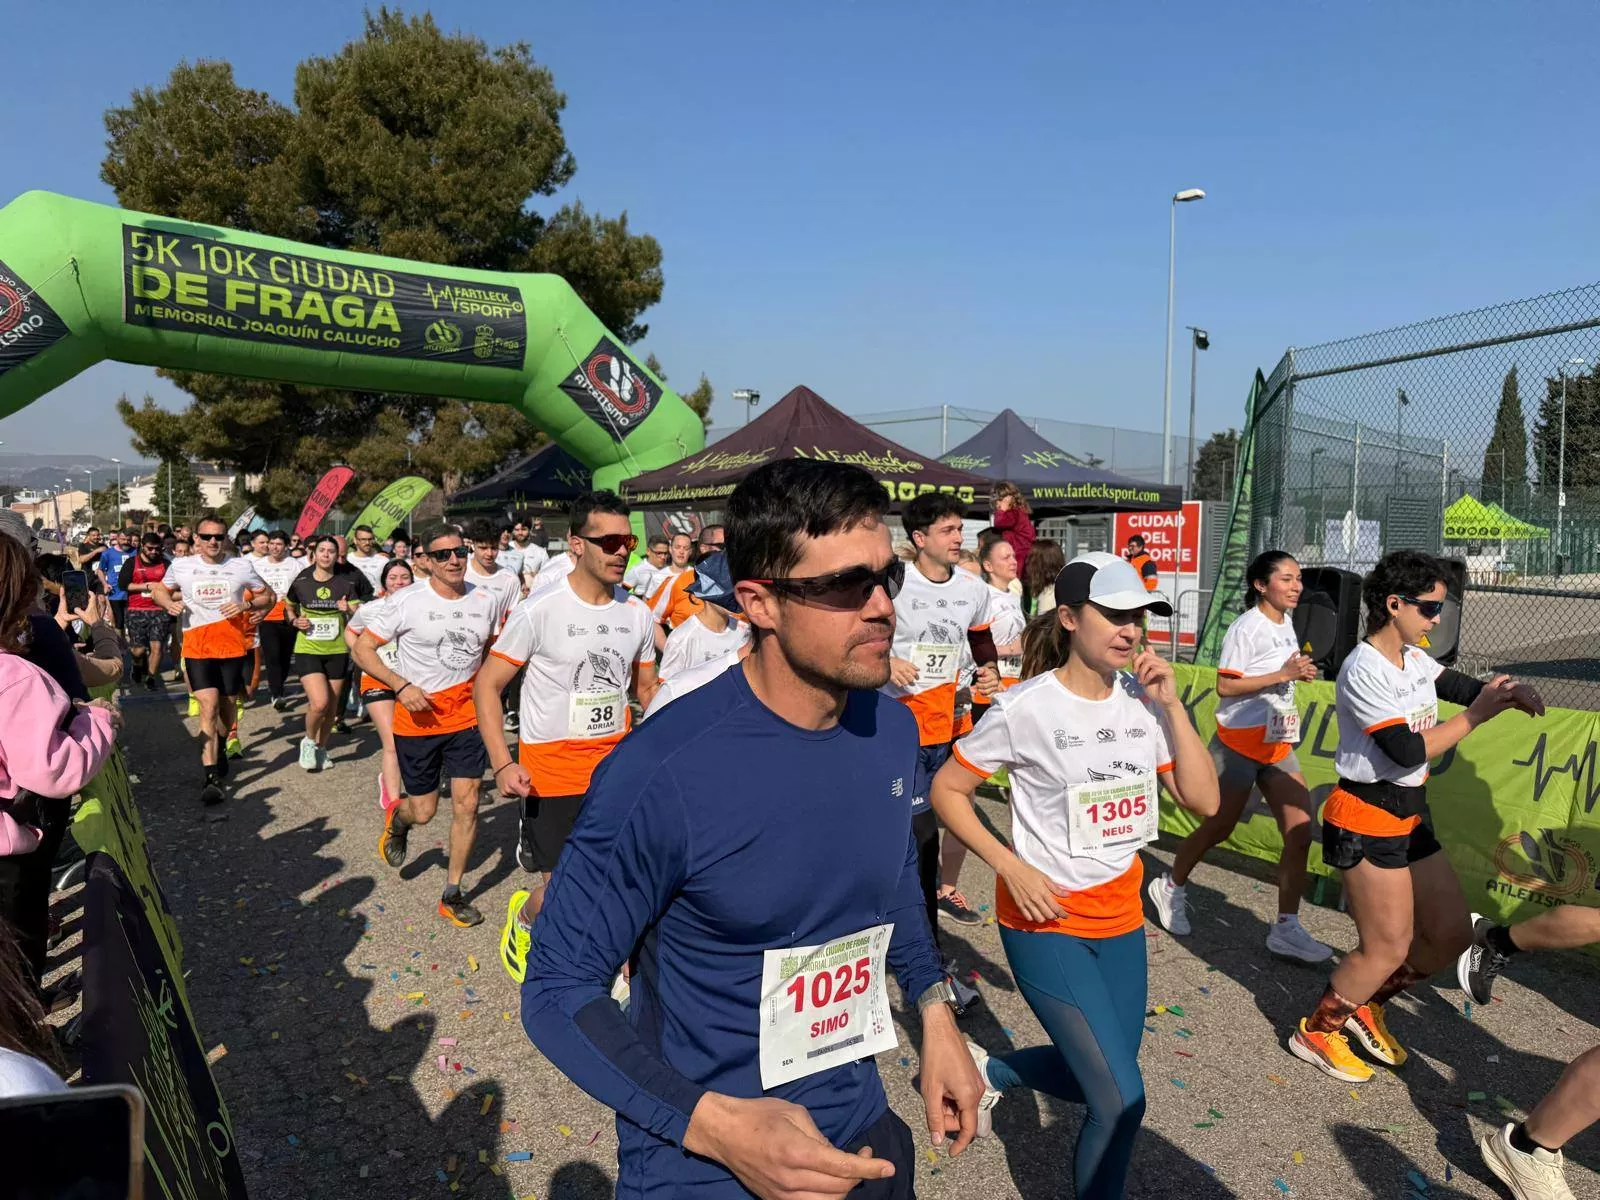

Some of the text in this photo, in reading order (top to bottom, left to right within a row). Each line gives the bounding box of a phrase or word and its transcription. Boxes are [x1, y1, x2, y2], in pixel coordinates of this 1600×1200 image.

[131, 231, 395, 298] 5K 10K CIUDAD
[132, 265, 401, 332] DE FRAGA
[454, 287, 511, 303] FARTLECK
[460, 301, 513, 319] SPORT
[134, 304, 400, 348] MEMORIAL JOAQUÍN CALUCHO
[1032, 482, 1160, 503] www.fartlecksport.com
[1128, 515, 1186, 528] CIUDAD
[1141, 531, 1170, 544] DEL
[1121, 548, 1192, 562] DORTE
[927, 654, 947, 668] 37
[591, 705, 613, 723] 38
[1272, 714, 1296, 726] 1115
[1113, 760, 1123, 769] 5K
[1125, 762, 1138, 773] 10K
[1086, 795, 1147, 823] 1305
[1102, 825, 1133, 837] NEUS
[787, 957, 872, 1013] 1025
[810, 1008, 849, 1038] SIMÓ
[782, 1058, 794, 1067] SEN
